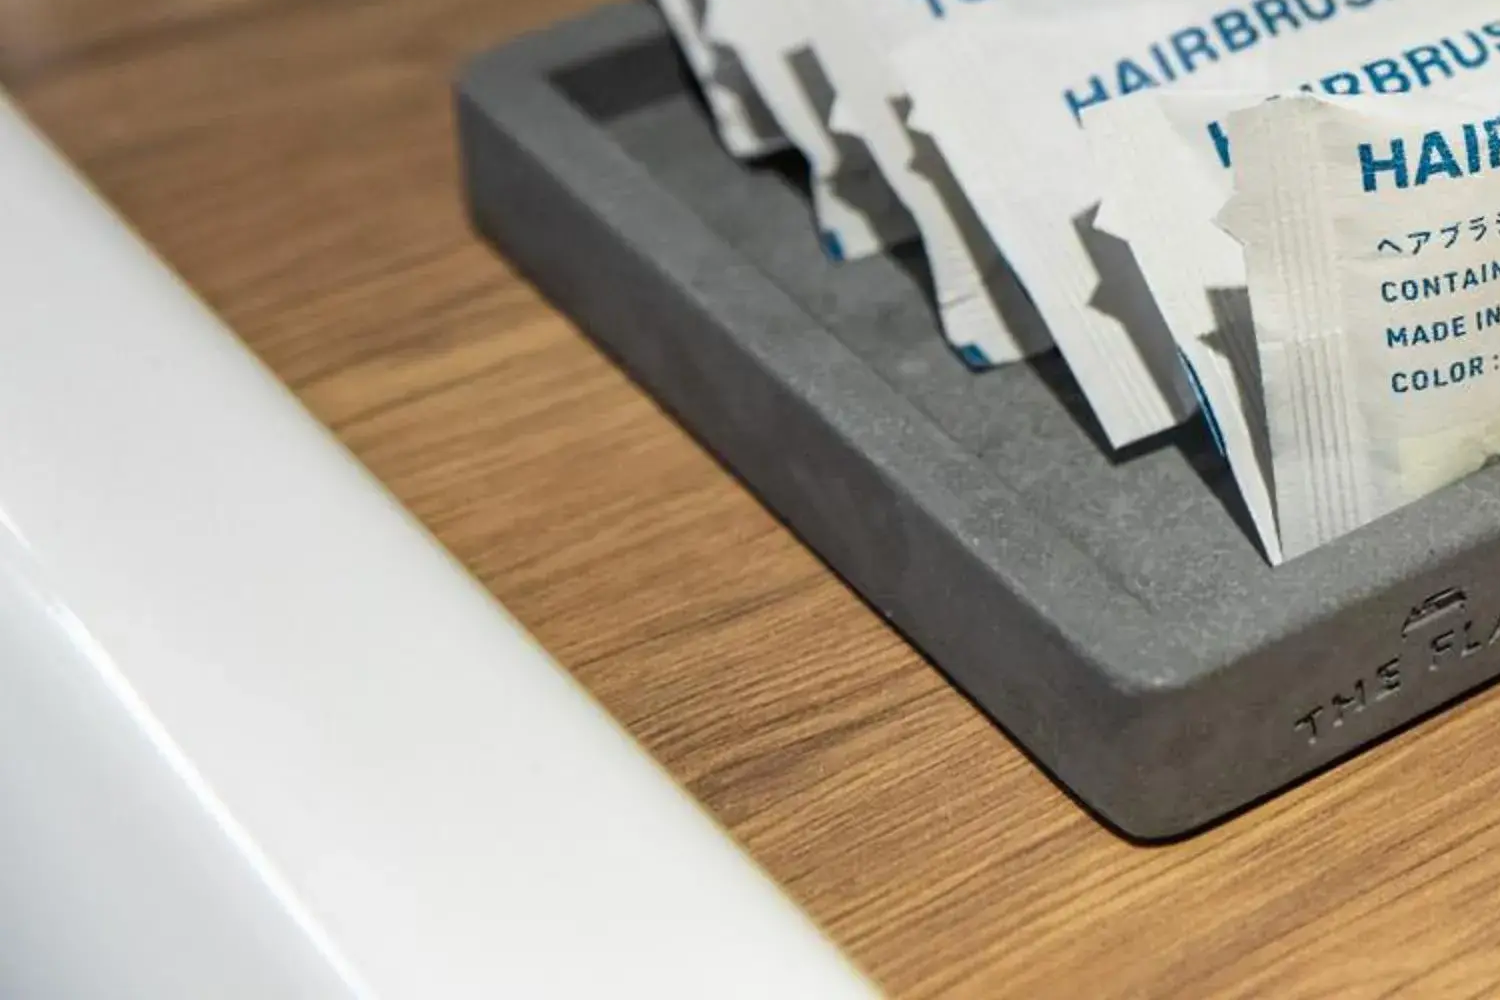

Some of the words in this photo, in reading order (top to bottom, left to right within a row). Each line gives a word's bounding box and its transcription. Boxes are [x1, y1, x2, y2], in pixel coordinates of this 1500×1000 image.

[1386, 315, 1467, 349] MADE
[1391, 356, 1485, 394] COLOR
[1293, 654, 1402, 744] THE
